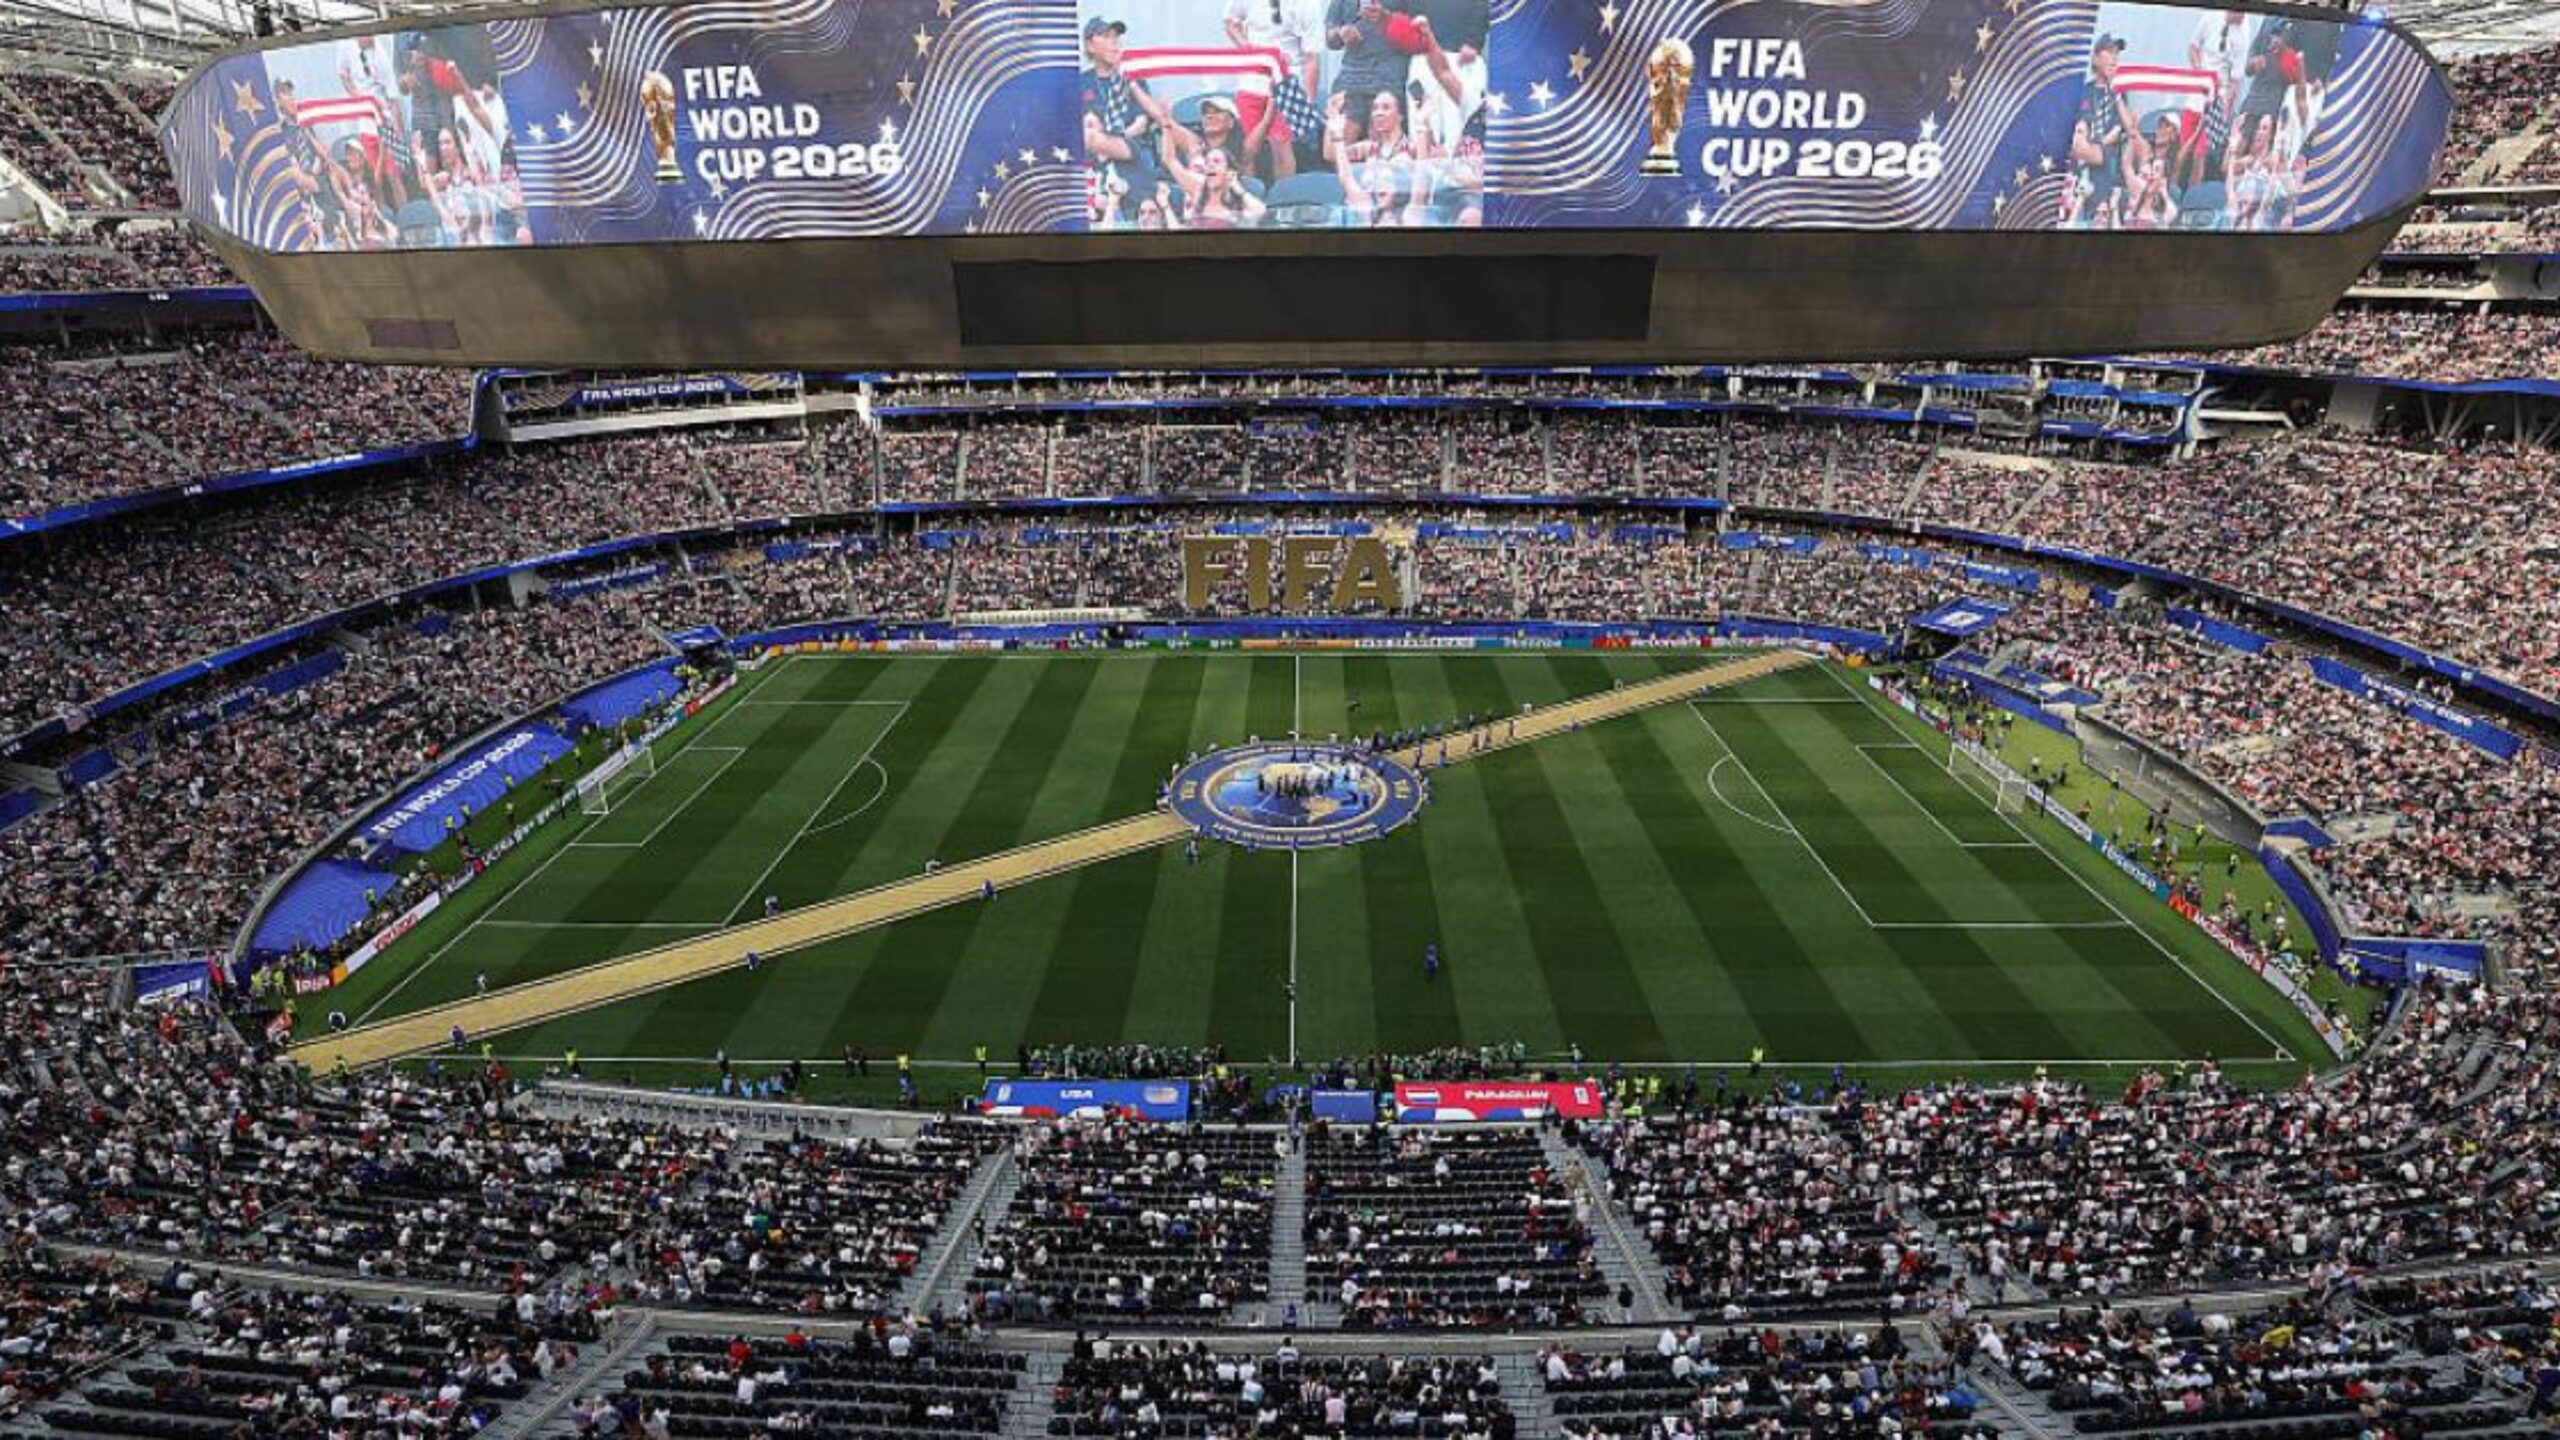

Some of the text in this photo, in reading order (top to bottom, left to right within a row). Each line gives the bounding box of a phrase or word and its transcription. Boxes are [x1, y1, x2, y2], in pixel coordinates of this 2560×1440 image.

[1711, 38, 1806, 79] FIFA
[683, 65, 762, 101] FIFA
[688, 103, 820, 141] WORLD
[1706, 89, 1867, 129] WORLD
[696, 143, 902, 181] CUP 2026
[1701, 138, 1944, 178] CUP 2026
[613, 384, 656, 397] WORLD
[658, 383, 681, 394] CUP
[685, 379, 725, 392] 2026
[1184, 534, 1401, 609] FIFA
[404, 777, 461, 812] WORLD
[457, 760, 488, 781] CUP
[484, 732, 534, 763] 2026
[1060, 1089, 1094, 1099] USA
[1464, 1089, 1548, 1100] PARAGUAY
